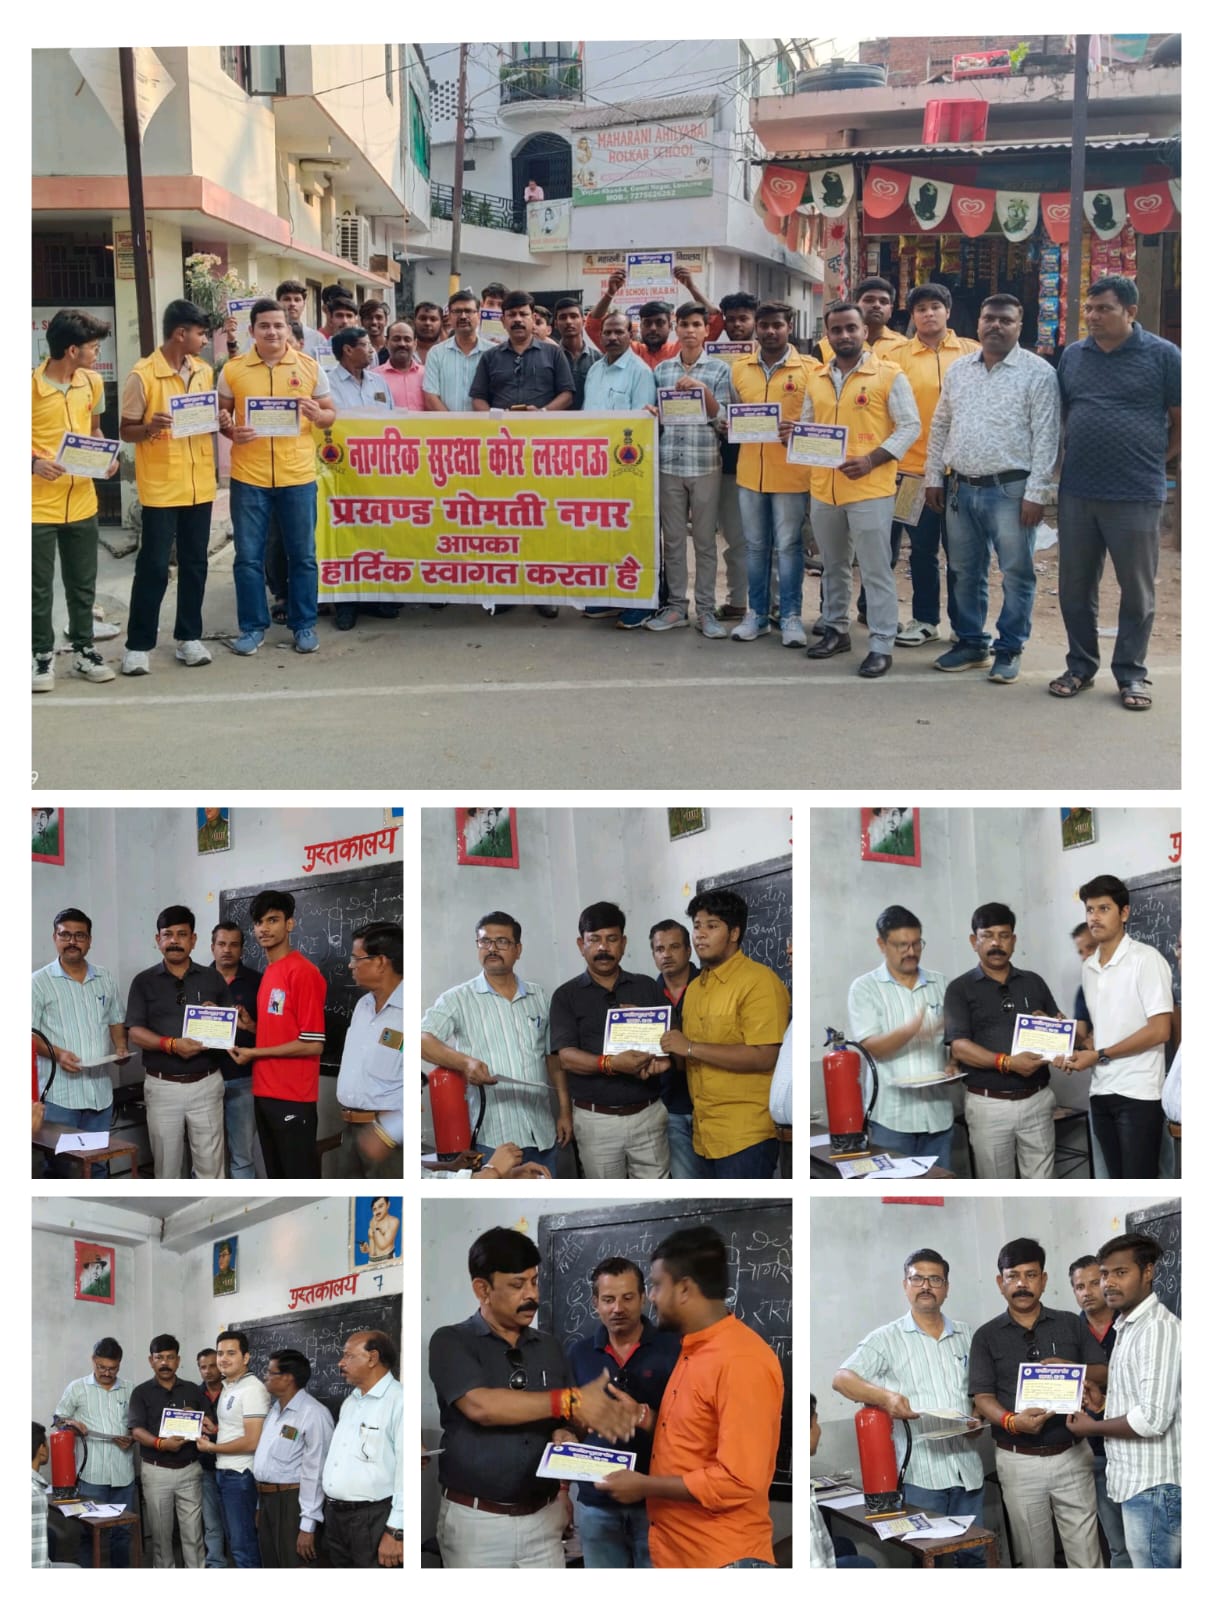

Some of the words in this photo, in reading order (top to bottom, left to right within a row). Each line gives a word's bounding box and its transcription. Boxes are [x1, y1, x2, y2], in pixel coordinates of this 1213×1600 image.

[598, 127, 652, 148] MAHARANI
[608, 148, 649, 163] HOLKAR
[653, 143, 695, 160] SCHOOL
[347, 427, 420, 476] नागरिक
[426, 436, 481, 487] सुरक्षा
[487, 427, 526, 476] कोर
[531, 437, 609, 477] लखनऊ
[329, 498, 433, 525] प्रखण्ड
[442, 492, 546, 527] गोमती
[557, 501, 631, 528] नगर
[436, 535, 520, 554] आपका
[320, 552, 414, 585] हार्दिक
[421, 560, 518, 585] स्वागत
[526, 563, 608, 587] करता
[615, 555, 641, 590] है
[302, 827, 399, 873] पुस्तकालय
[287, 1273, 360, 1310] पुस्तकालय
[373, 1274, 384, 1292] 7
